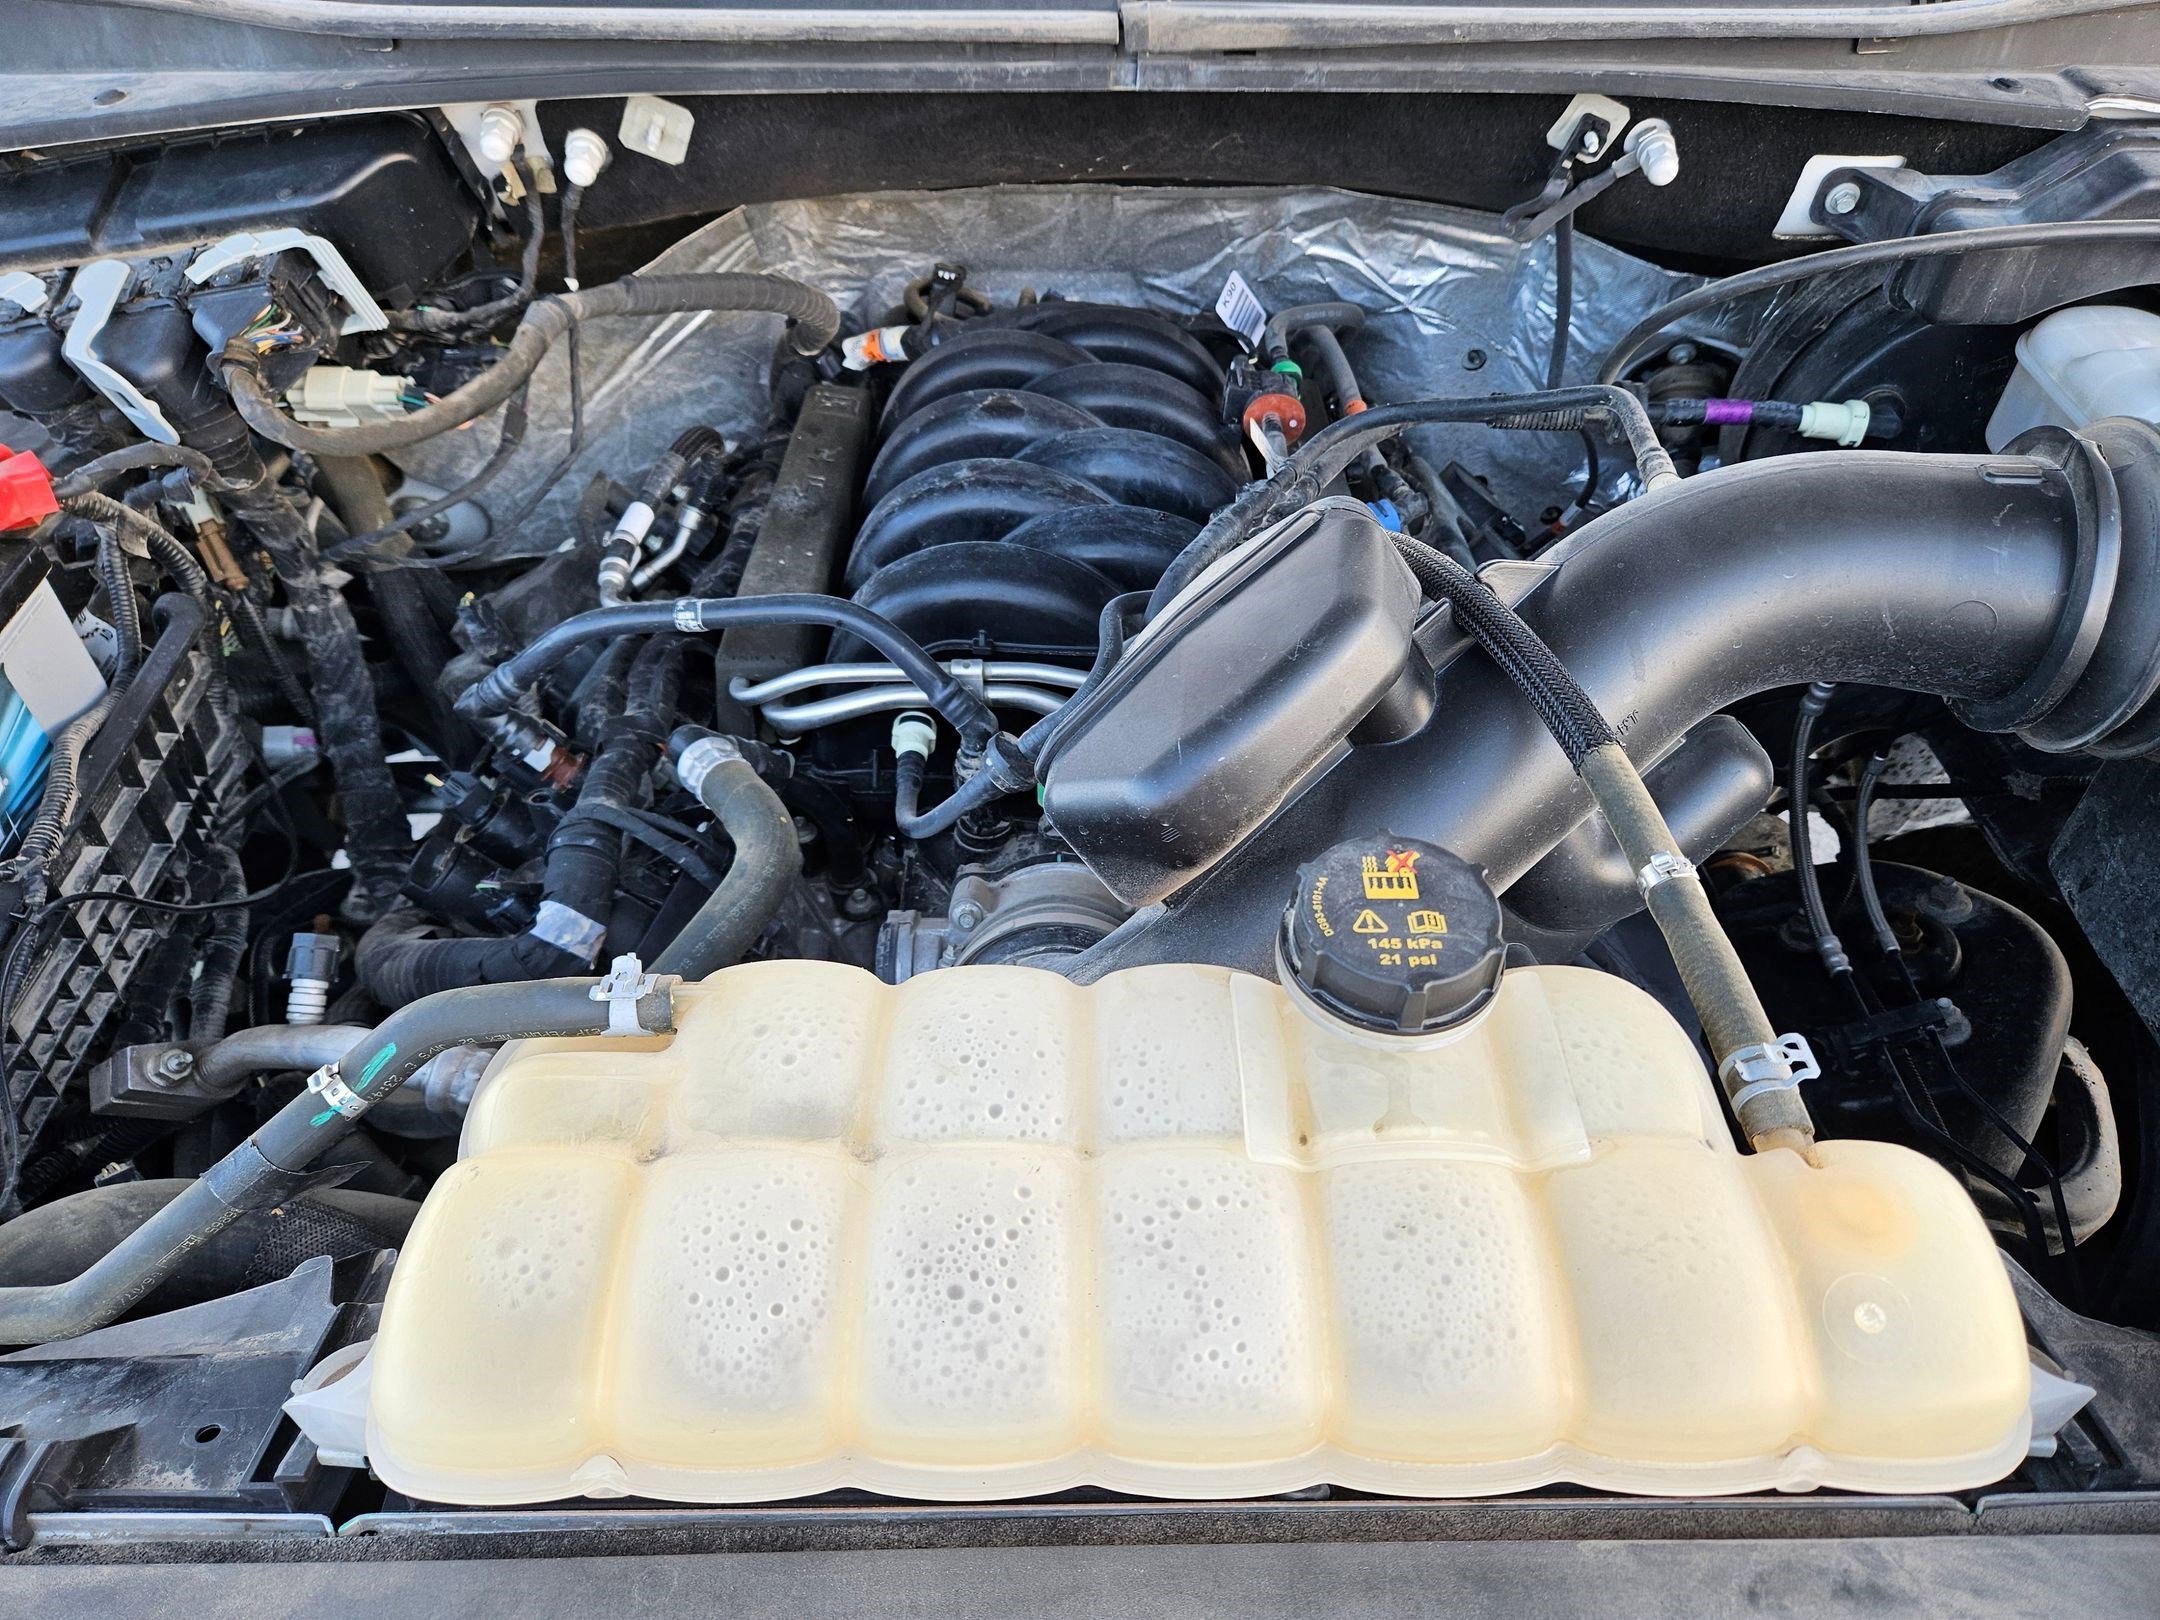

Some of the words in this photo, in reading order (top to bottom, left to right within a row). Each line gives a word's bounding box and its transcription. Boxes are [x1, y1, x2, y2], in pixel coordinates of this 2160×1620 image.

[1367, 937, 1402, 950] 145
[1406, 937, 1444, 950] kPa
[1379, 953, 1401, 966] 21
[1407, 953, 1438, 968] psi
